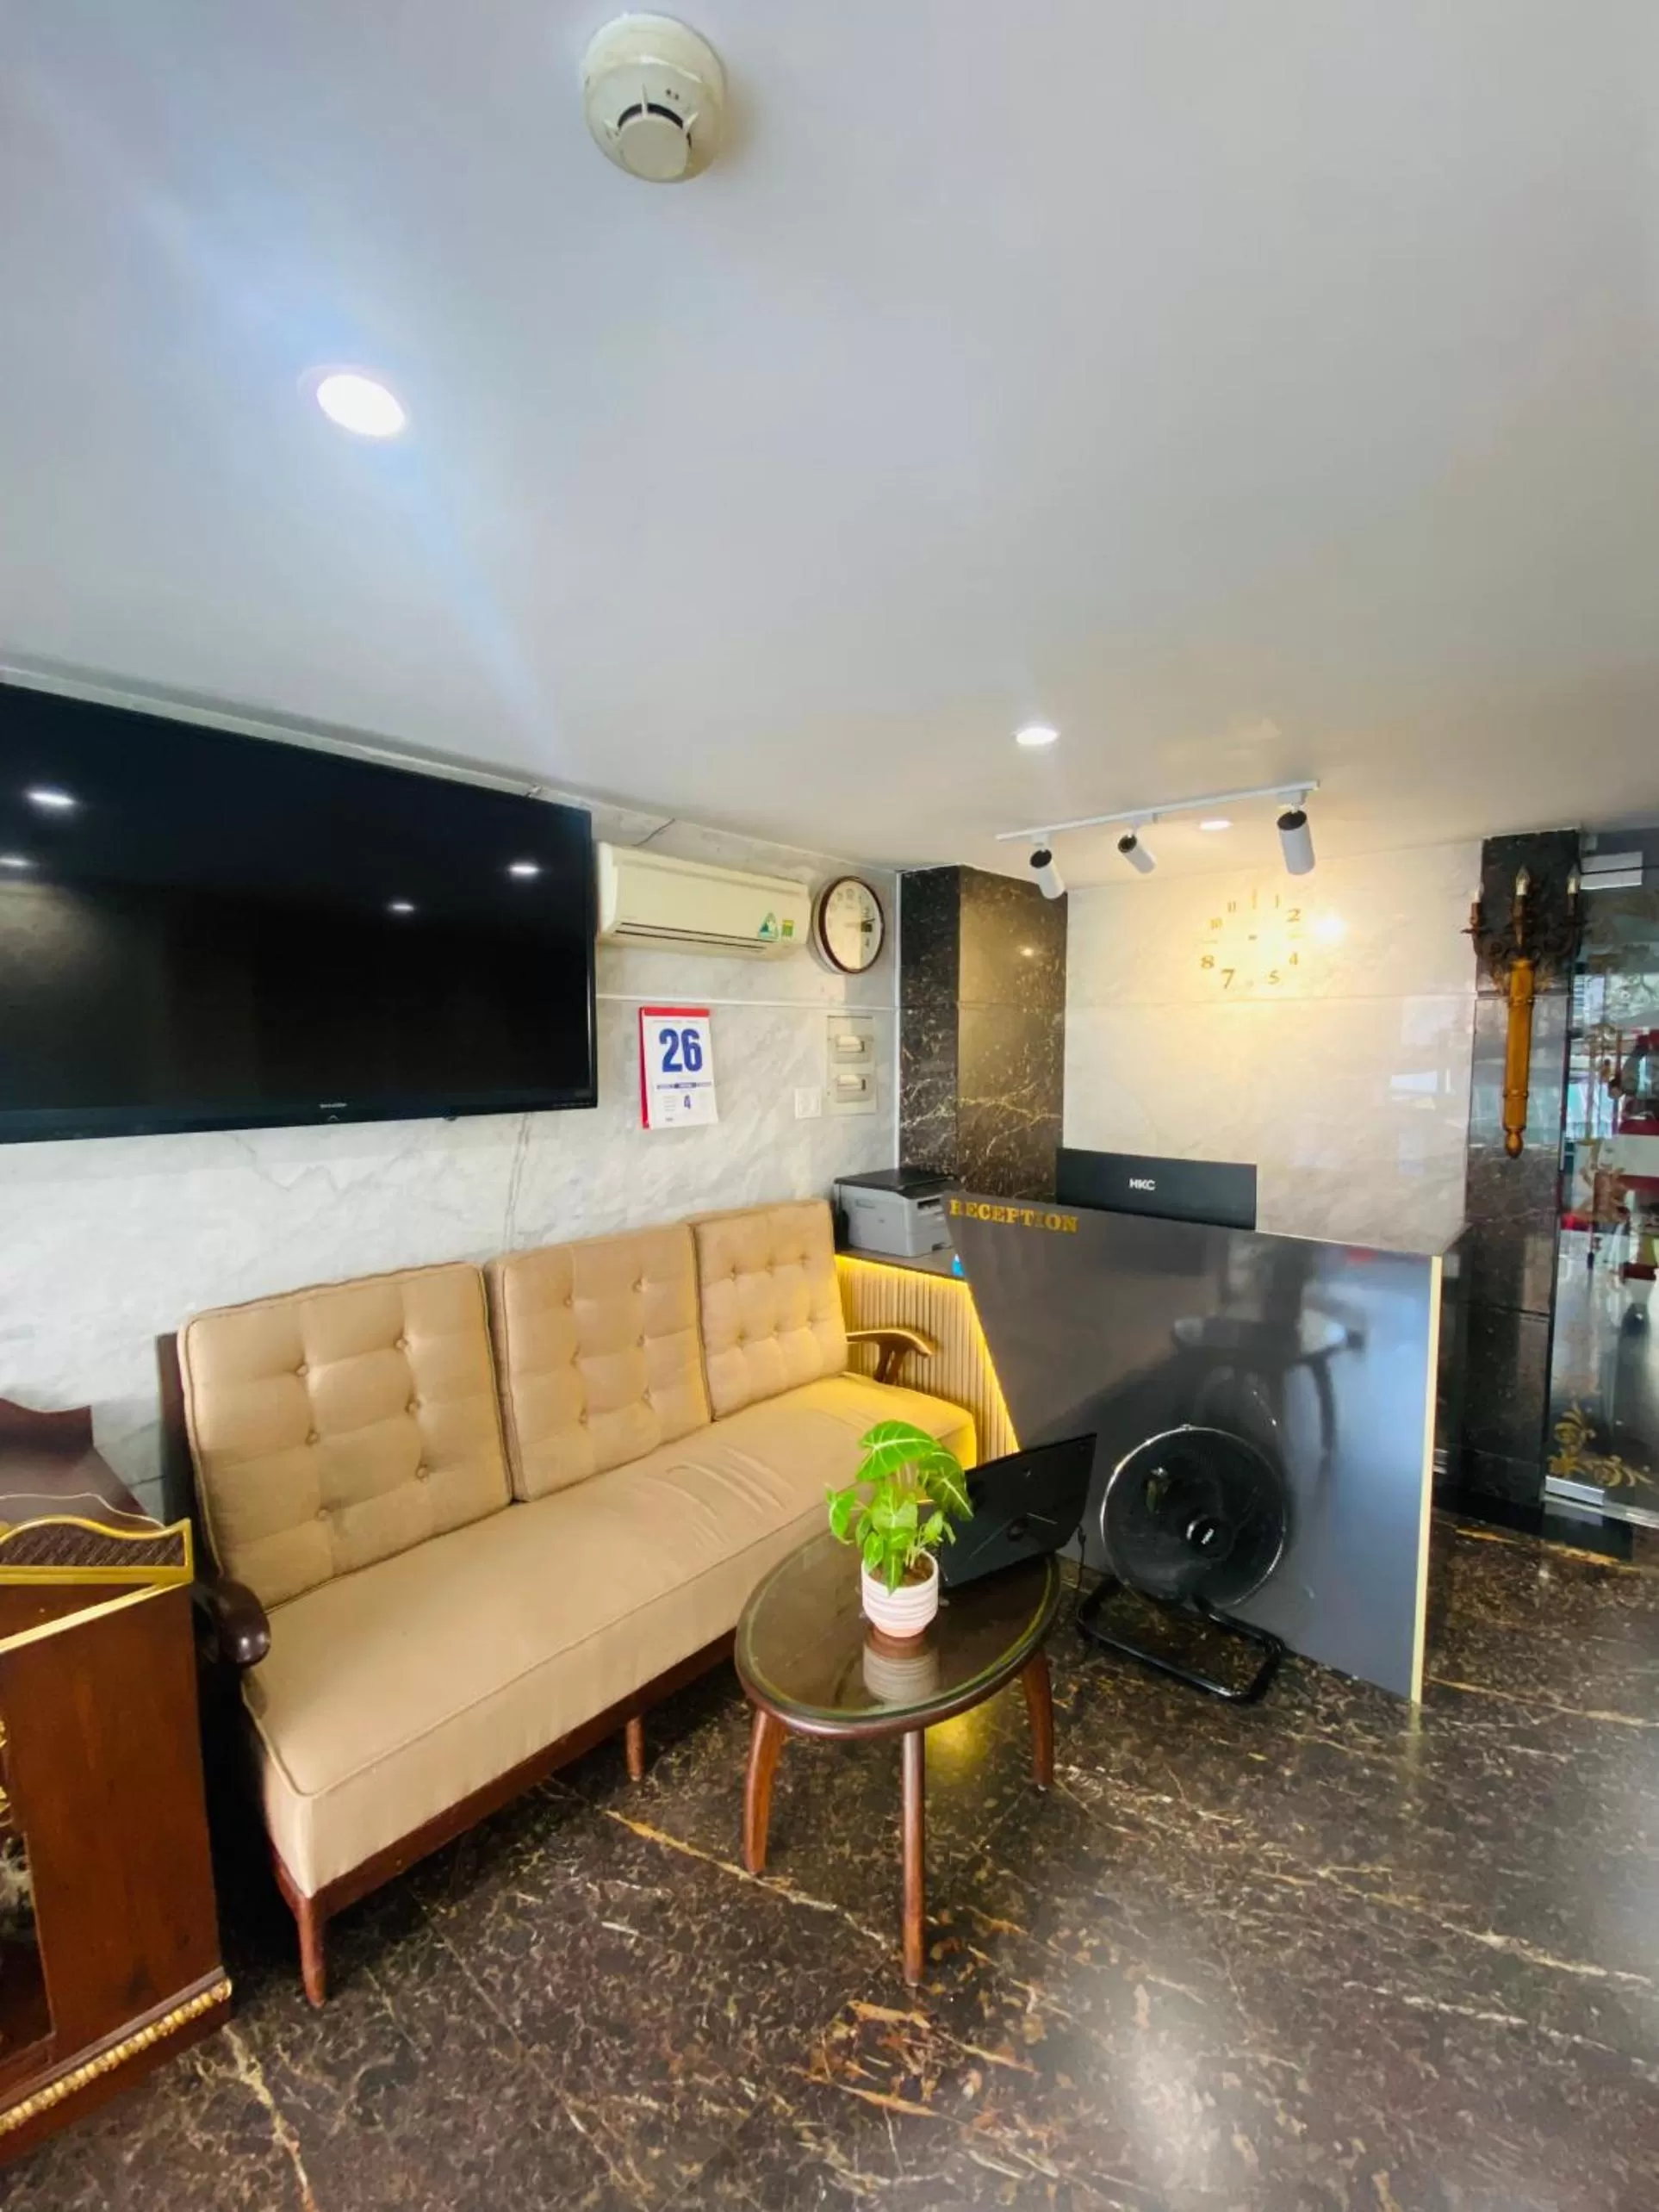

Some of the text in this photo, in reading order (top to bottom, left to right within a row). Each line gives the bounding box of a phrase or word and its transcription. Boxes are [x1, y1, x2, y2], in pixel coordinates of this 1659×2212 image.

[1286, 908, 1302, 923] 2
[1200, 954, 1215, 969] 8
[1221, 967, 1236, 990] 7
[1267, 969, 1282, 985] 5
[659, 1028, 703, 1072] 26
[1128, 1177, 1156, 1191] HKC
